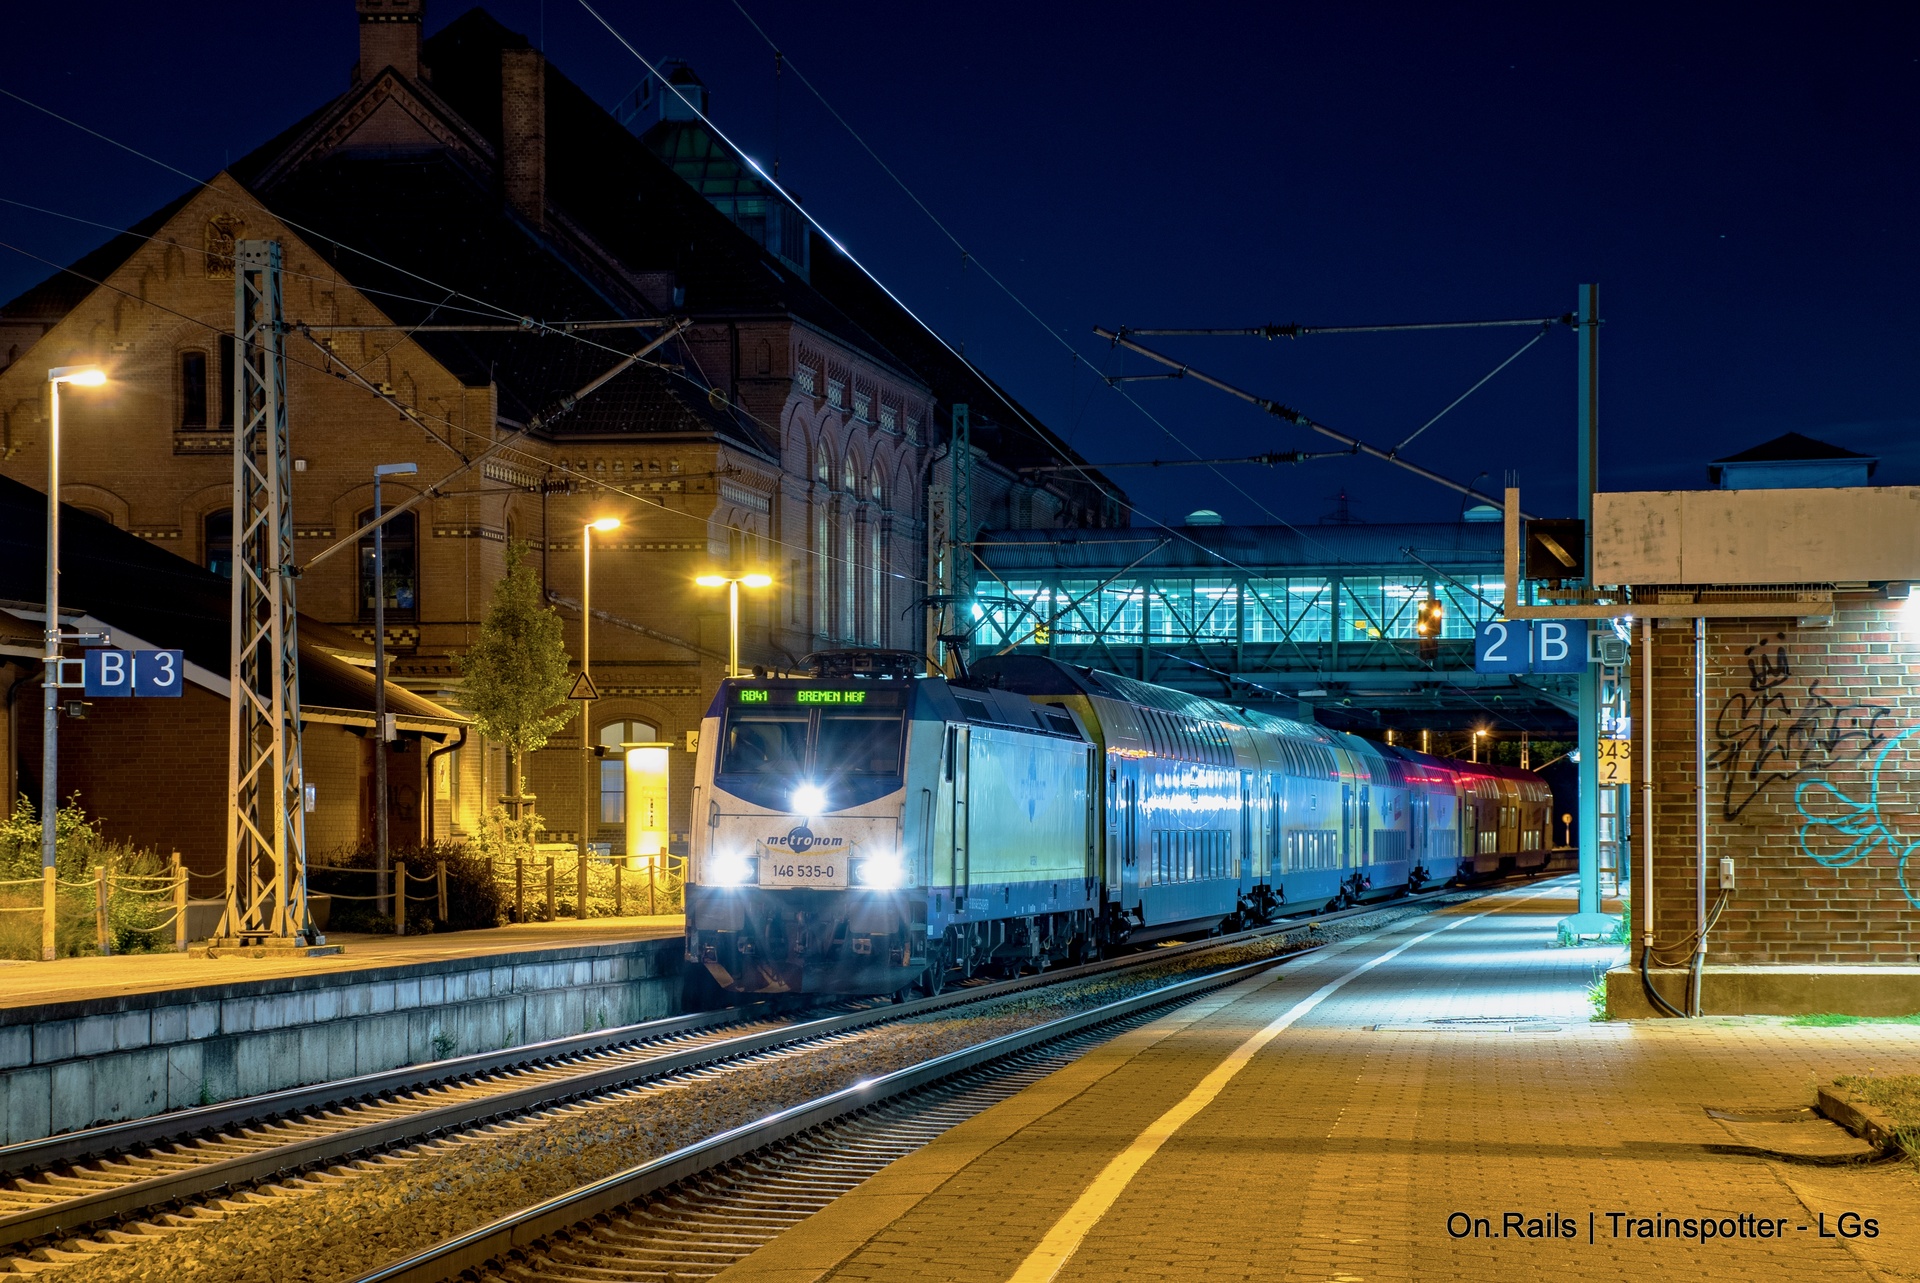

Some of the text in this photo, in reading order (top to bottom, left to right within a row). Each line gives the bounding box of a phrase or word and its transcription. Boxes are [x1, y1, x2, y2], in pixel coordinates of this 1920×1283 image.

[1483, 623, 1569, 662] 2 B
[101, 652, 175, 687] B 3
[741, 690, 866, 703] RB41 BREMEN HBF
[1606, 762, 1618, 779] 2
[766, 834, 843, 846] metronom
[773, 864, 834, 878] 146 535-0
